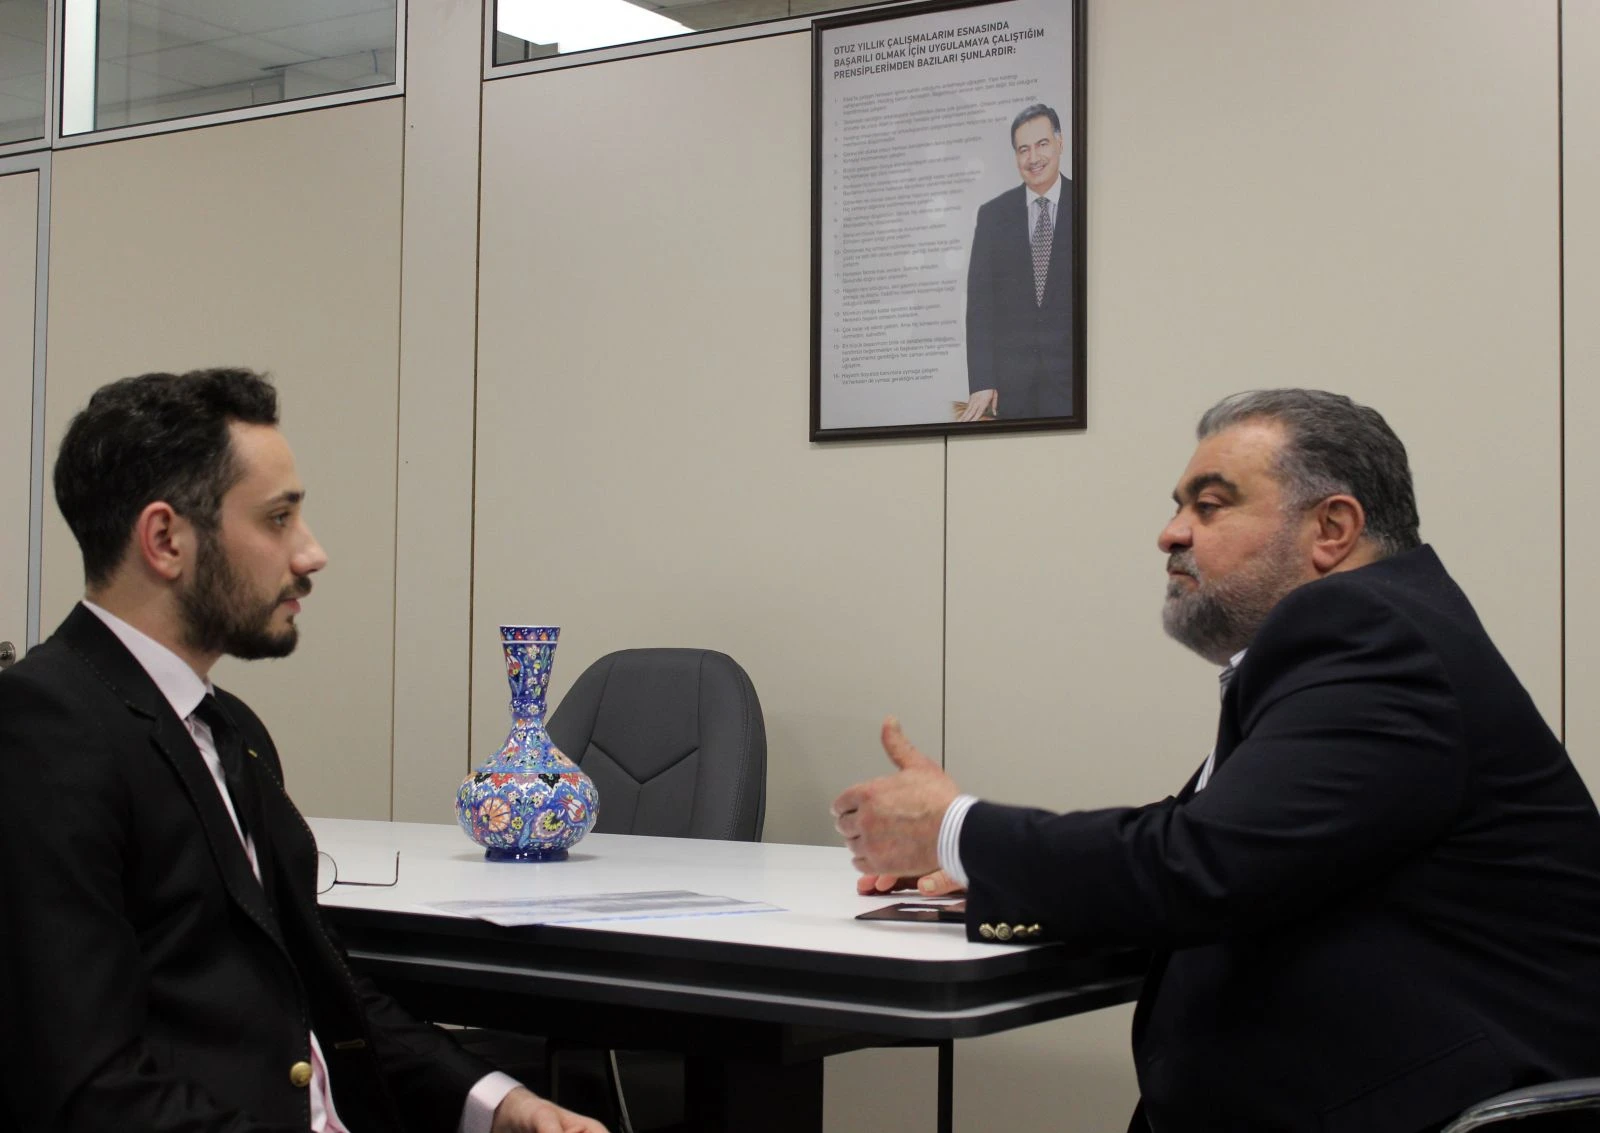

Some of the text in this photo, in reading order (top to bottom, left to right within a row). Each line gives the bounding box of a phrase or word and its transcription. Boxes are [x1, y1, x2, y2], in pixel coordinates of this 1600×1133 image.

[834, 21, 1010, 55] OTUZ YILLIK ÇALIŞMALARIM ESNASINDA
[834, 28, 1045, 68] BAŞARILI OLMAK İÇİN UYGULAMAYA ÇALIŞTIĞIM
[834, 46, 1016, 79] PRENSİPLERİMDEN BAZILARI ŞUNLARDIR:
